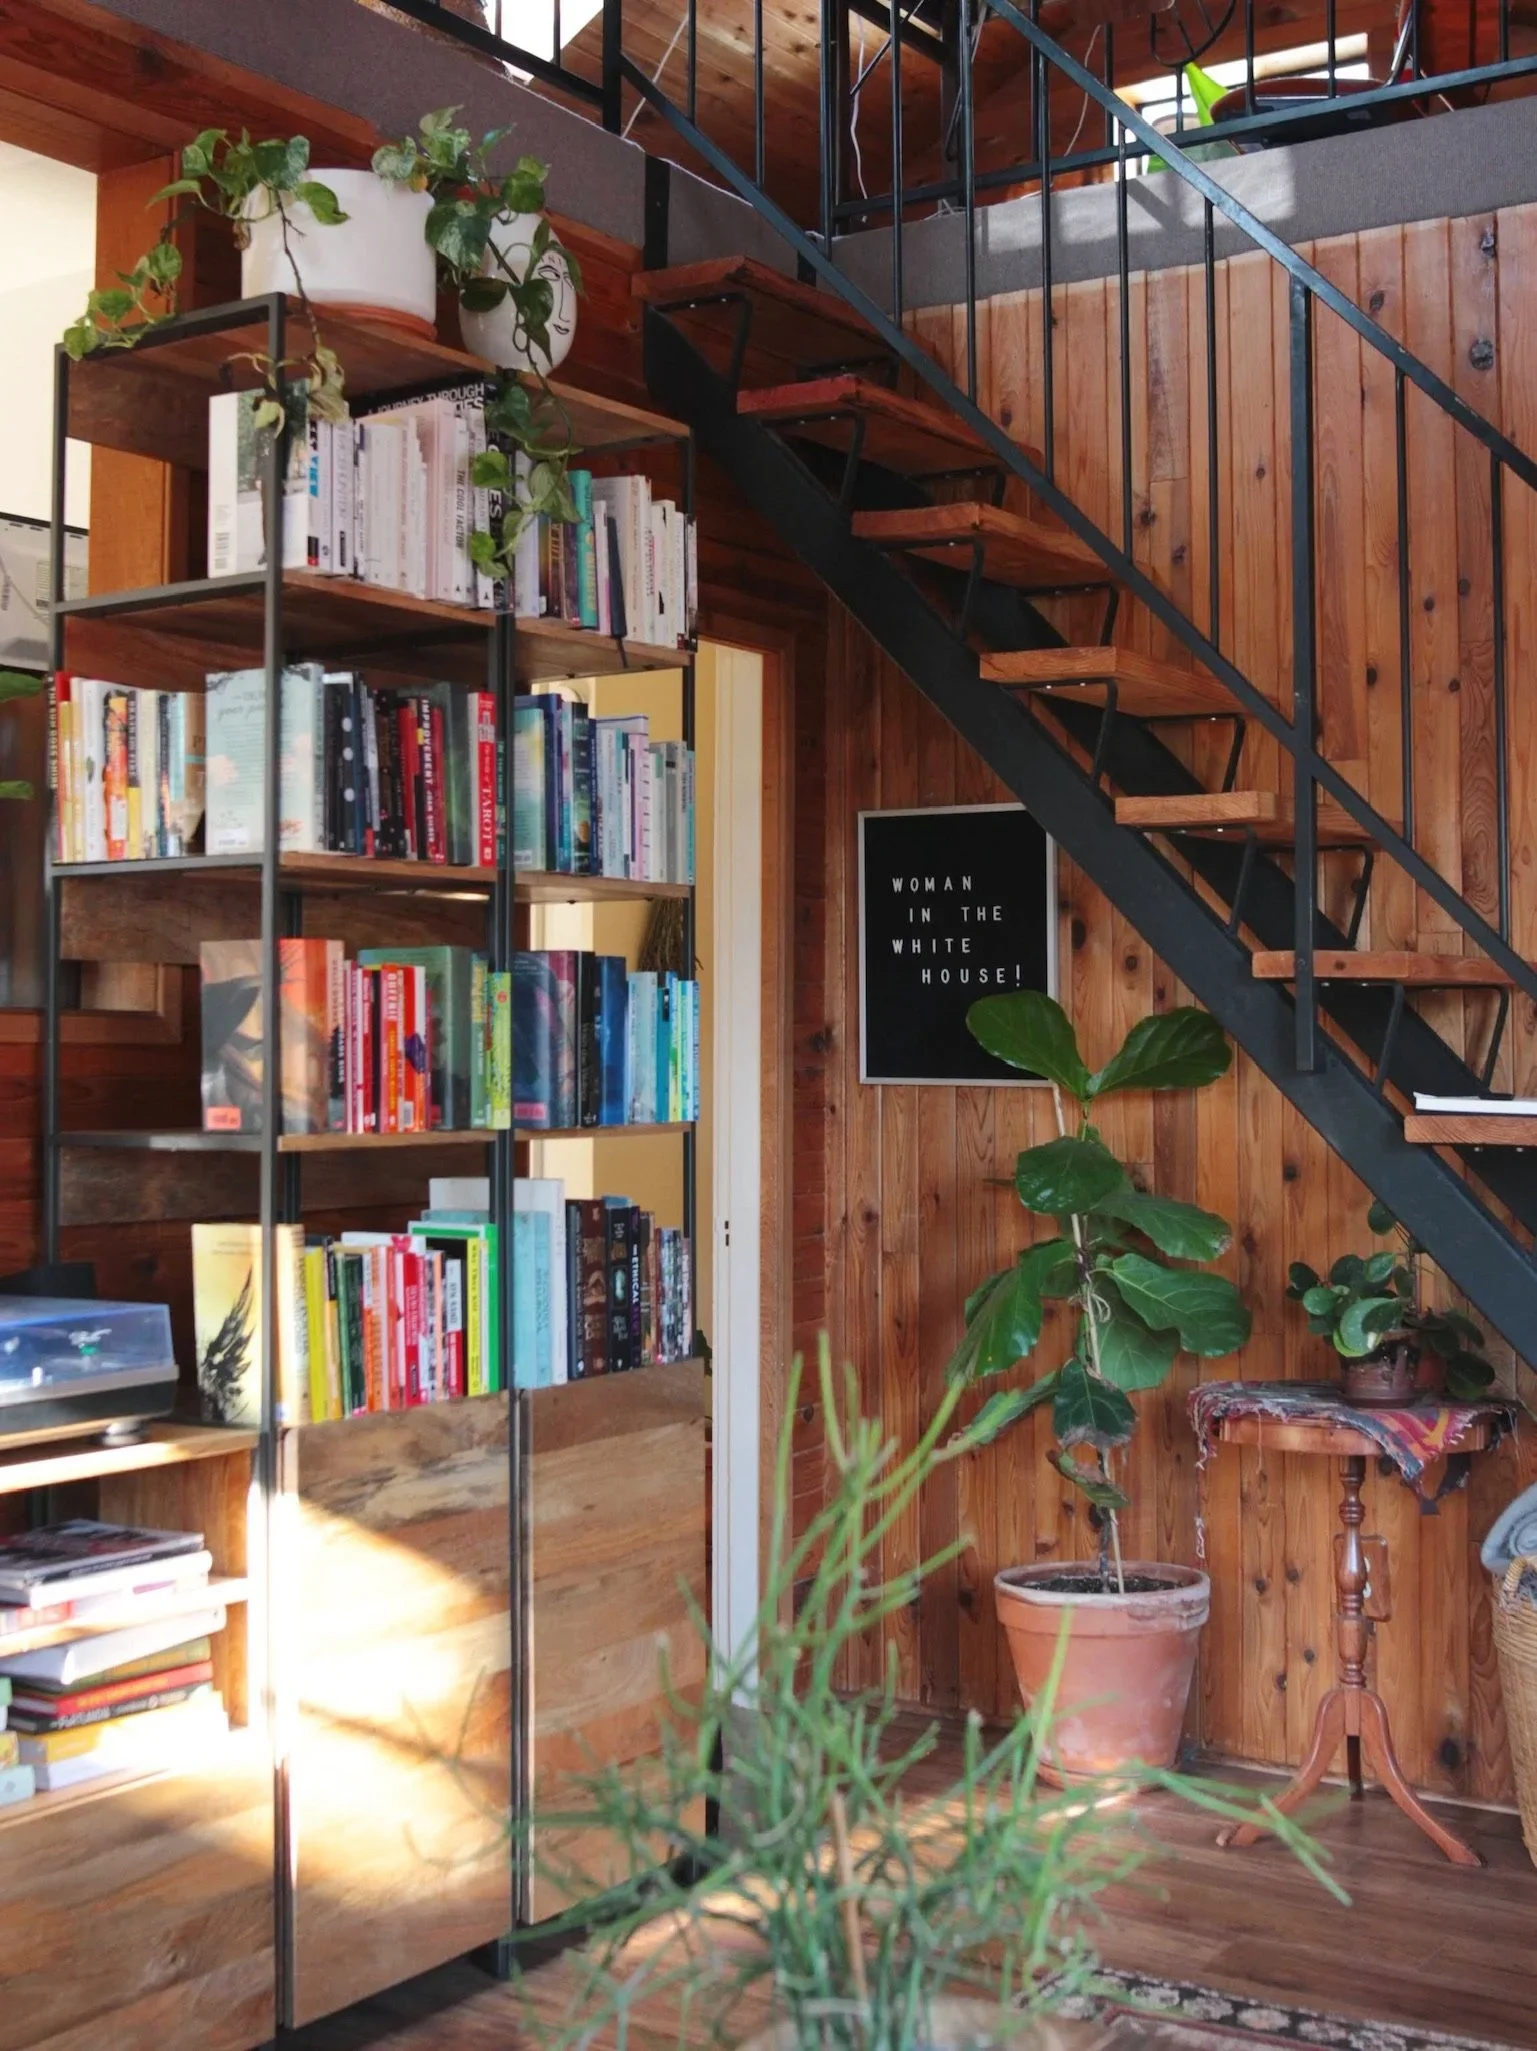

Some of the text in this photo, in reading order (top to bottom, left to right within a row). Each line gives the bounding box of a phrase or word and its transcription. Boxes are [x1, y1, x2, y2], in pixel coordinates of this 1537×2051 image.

[427, 382, 485, 402] THROUGH
[456, 489, 465, 512] COOL
[455, 515, 465, 550] FACTOR
[422, 699, 433, 785] IMPROVEMENT
[482, 788, 493, 840] TAROT
[892, 875, 972, 892] WOMAN
[909, 905, 1002, 923] IN THE
[892, 937, 971, 954] WHITE
[921, 964, 1021, 987] HOUSE!
